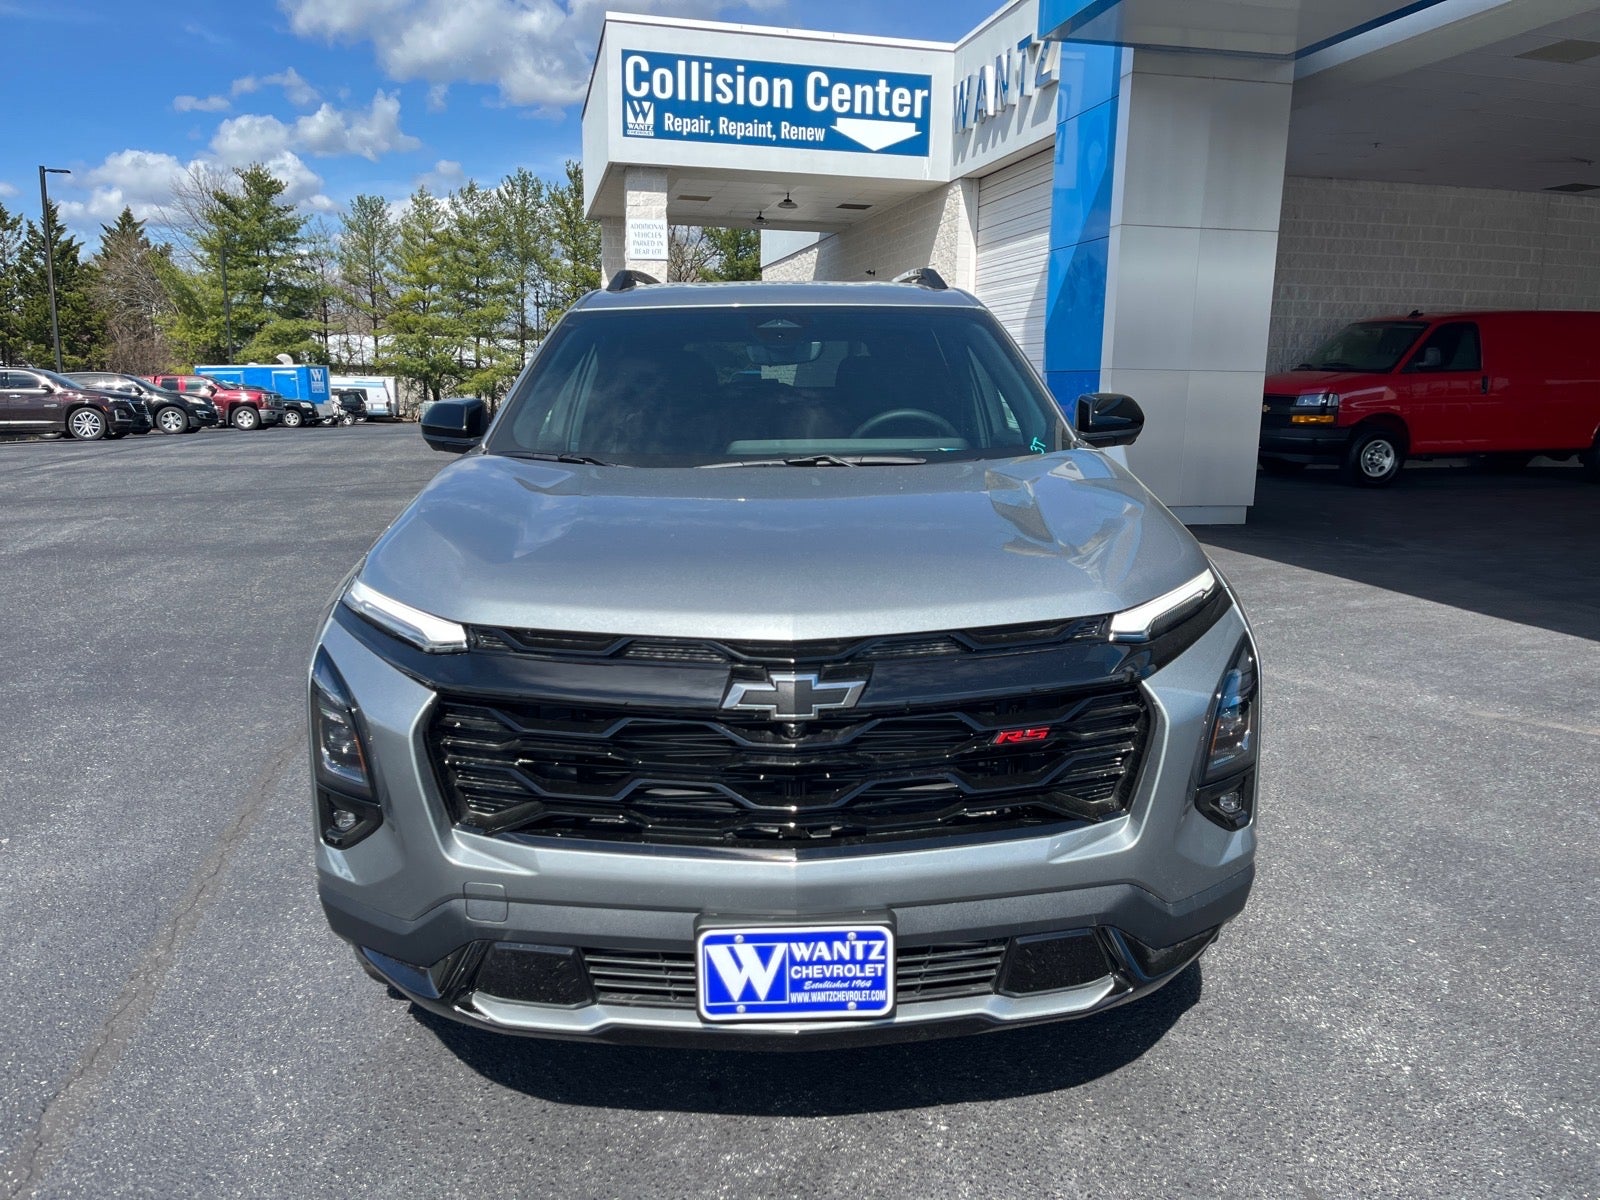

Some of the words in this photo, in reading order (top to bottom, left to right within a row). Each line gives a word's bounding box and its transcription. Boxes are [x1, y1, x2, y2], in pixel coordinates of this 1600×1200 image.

[625, 55, 793, 109] Collision
[806, 71, 929, 119] Center
[953, 34, 1058, 134] WANTZ
[627, 123, 654, 131] WANTZ
[664, 112, 715, 137] Repair,
[719, 116, 777, 141] Repaint,
[781, 121, 826, 142] Renew
[994, 726, 1051, 744] RS
[790, 940, 886, 962] WANTZ
[705, 943, 788, 1002] W
[790, 964, 885, 979] CHEVROLET
[803, 980, 850, 991] Established
[851, 979, 873, 988] 1964
[790, 990, 886, 1004] WWW.WANTZCHEVROLET.COM
